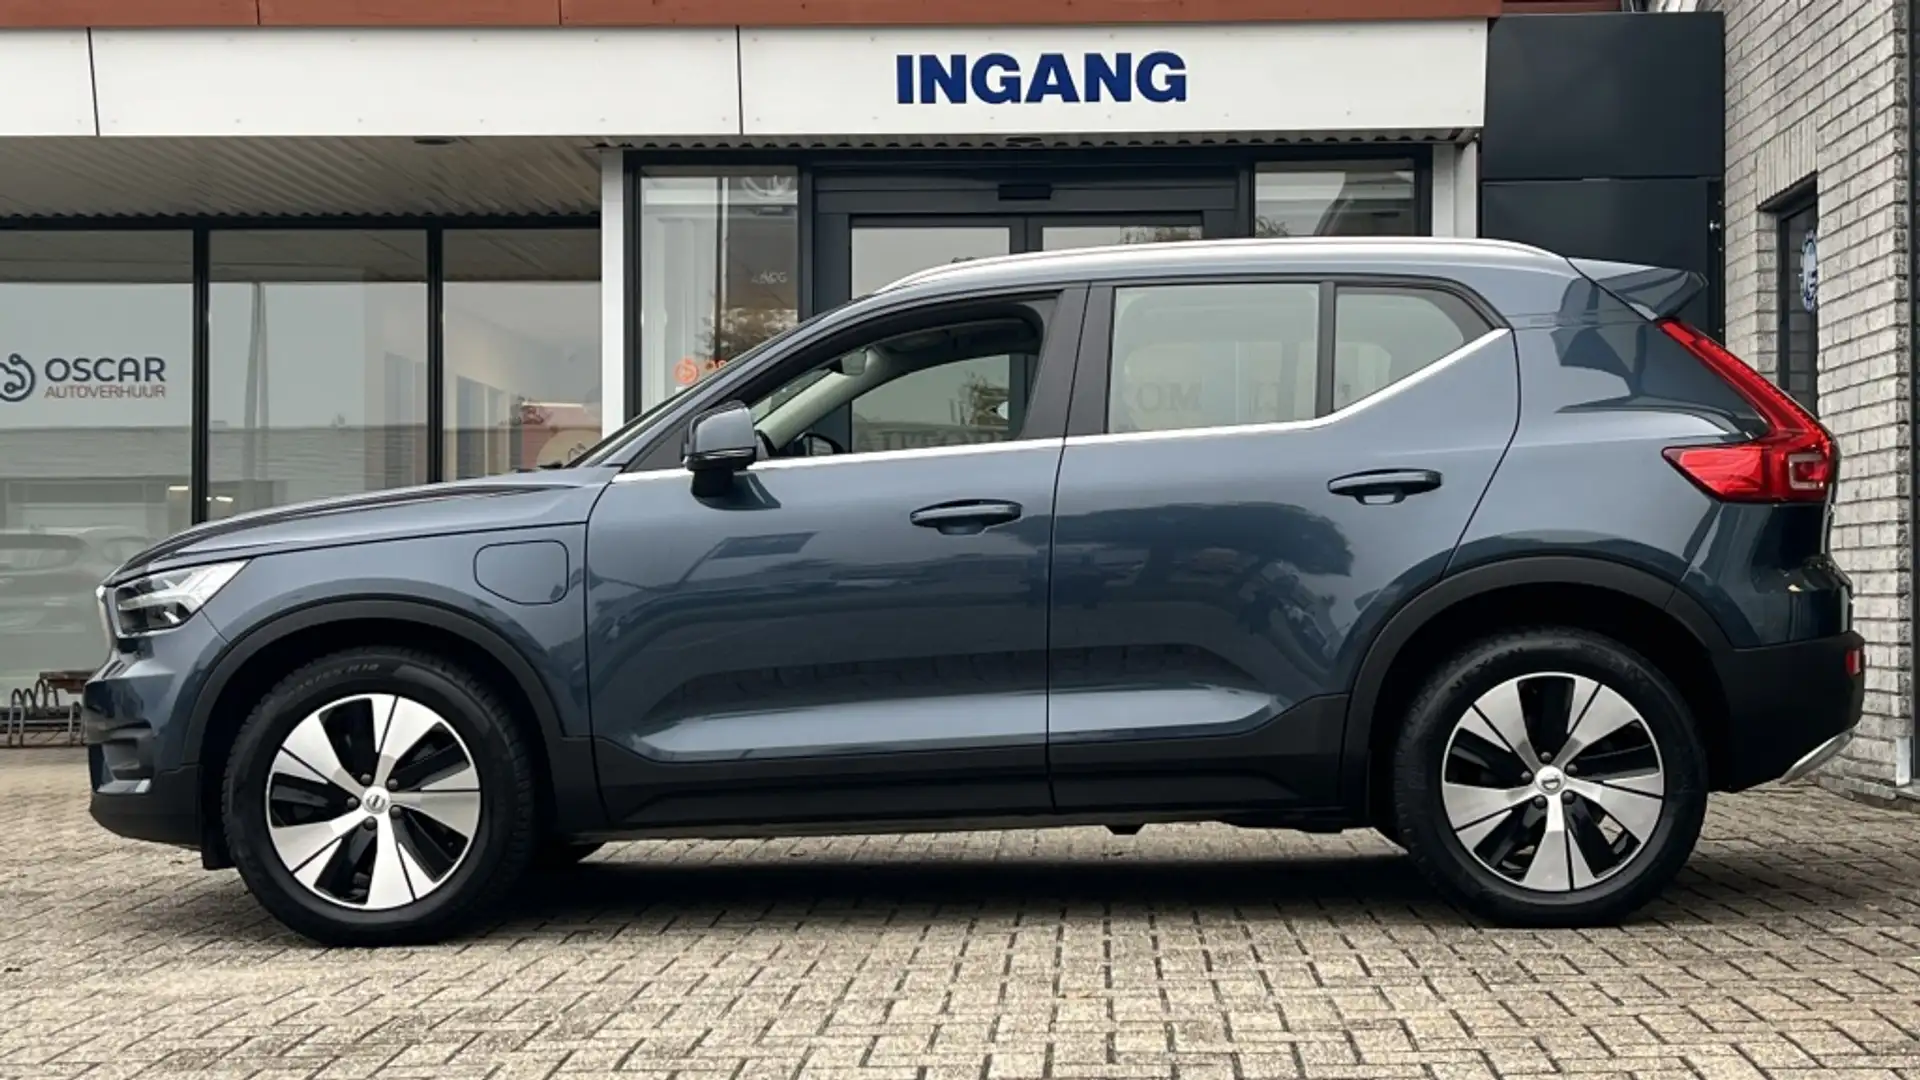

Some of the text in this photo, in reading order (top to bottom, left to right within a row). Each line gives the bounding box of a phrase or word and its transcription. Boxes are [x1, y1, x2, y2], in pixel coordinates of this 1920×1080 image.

[896, 51, 1187, 104] INGANG
[45, 357, 166, 382] OSCAR
[45, 385, 166, 398] AUTOVERHUUR
